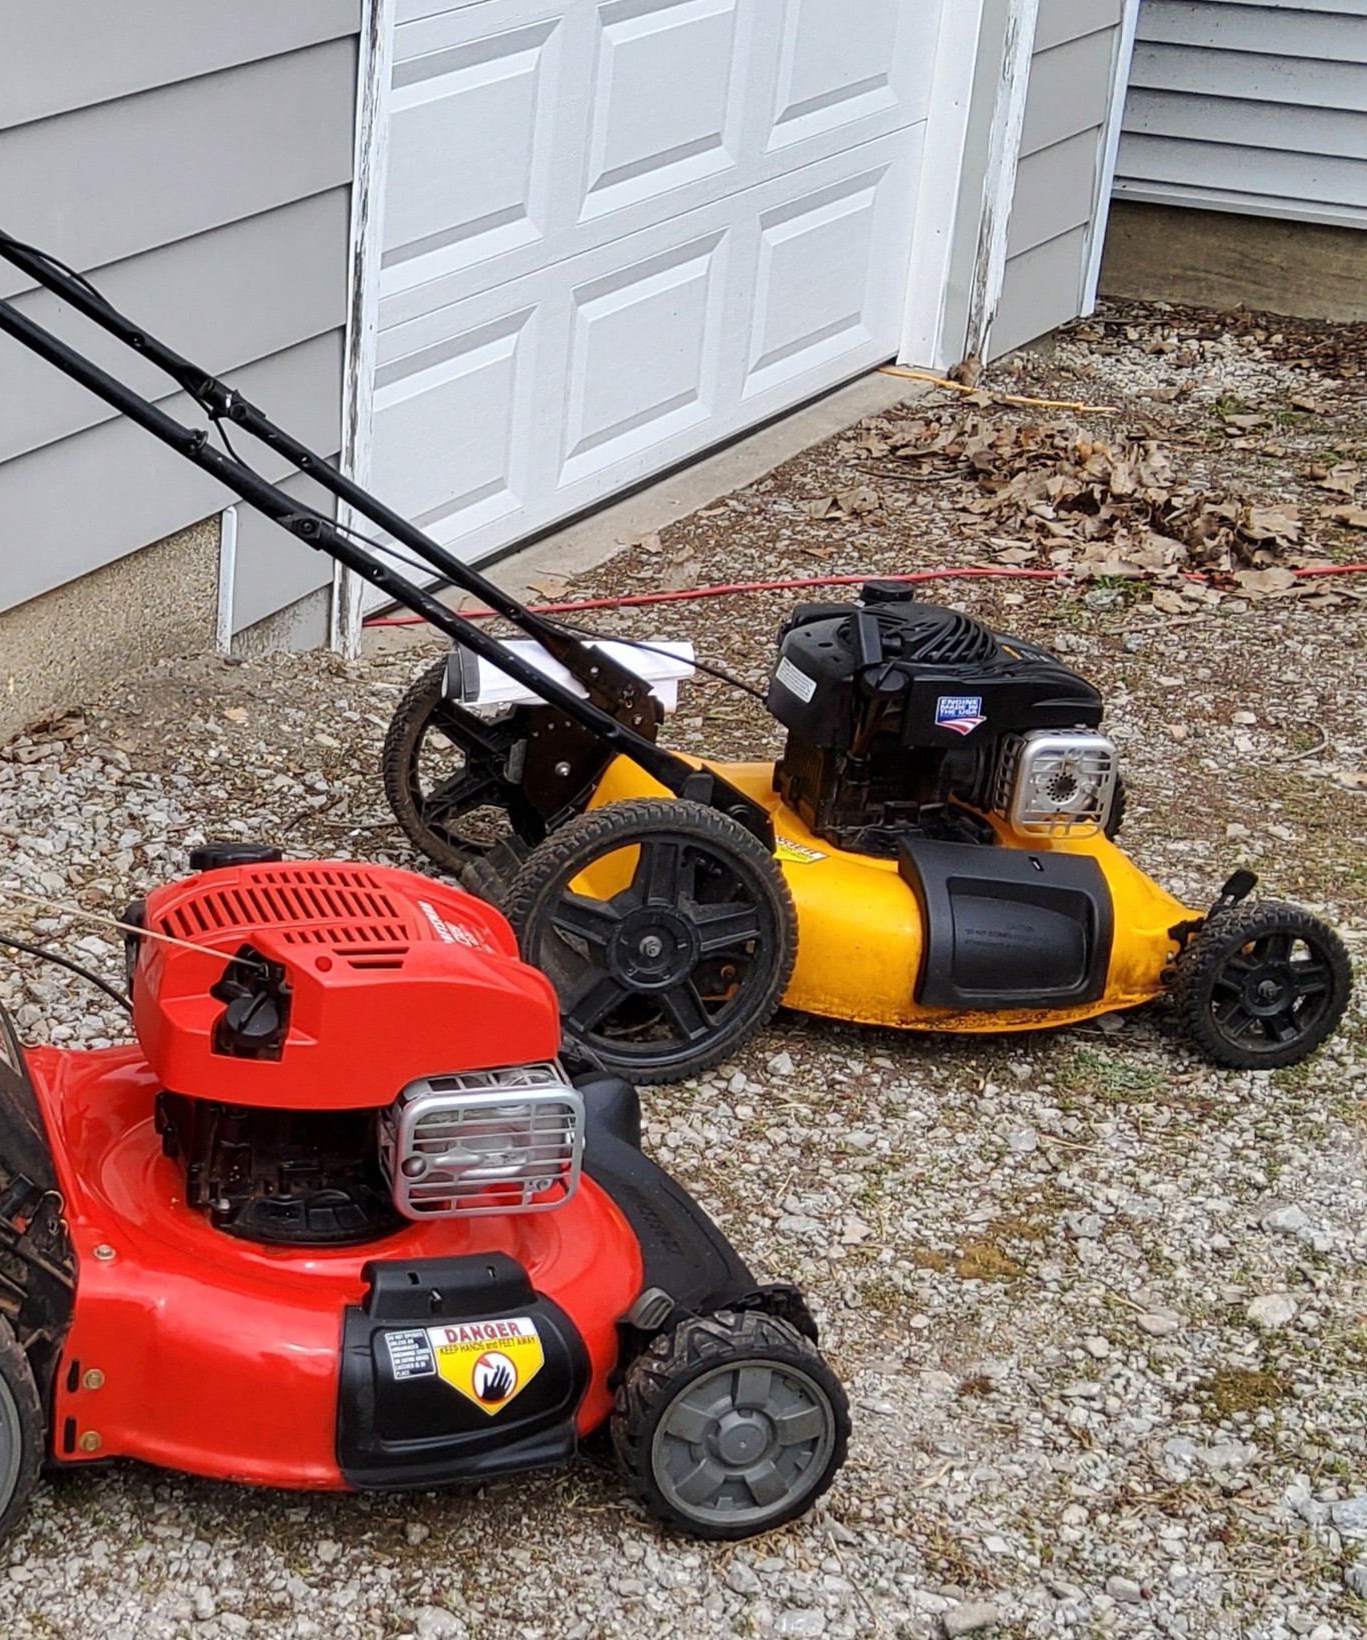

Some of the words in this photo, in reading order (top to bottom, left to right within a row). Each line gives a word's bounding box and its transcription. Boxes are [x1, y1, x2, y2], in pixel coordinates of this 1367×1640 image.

[444, 1322, 522, 1343] DANGER
[439, 1345, 459, 1355] KEEP
[460, 1341, 485, 1353] HANDS
[499, 1338, 516, 1348] FEET
[517, 1336, 536, 1346] AWAY
